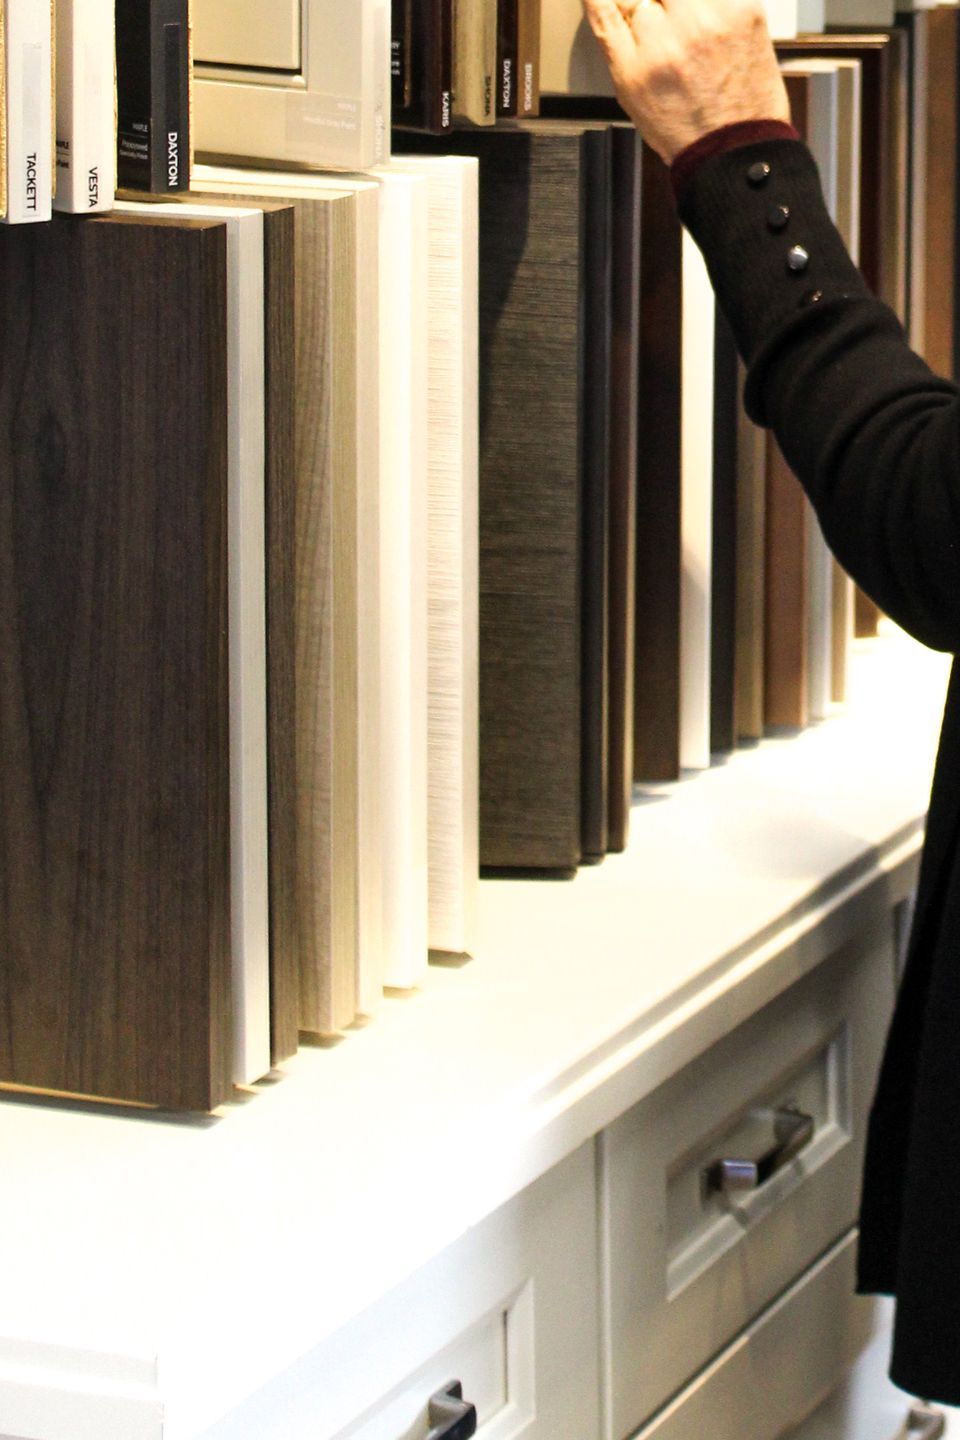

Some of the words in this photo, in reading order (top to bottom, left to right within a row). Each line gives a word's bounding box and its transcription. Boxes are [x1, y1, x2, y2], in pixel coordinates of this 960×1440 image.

[503, 59, 511, 108] DAXTON
[524, 63, 532, 111] BROOKS
[441, 91, 450, 128] KARIS
[26, 152, 37, 211] TACKETT
[168, 132, 178, 186] DAXTON
[88, 167, 99, 208] VESTA
